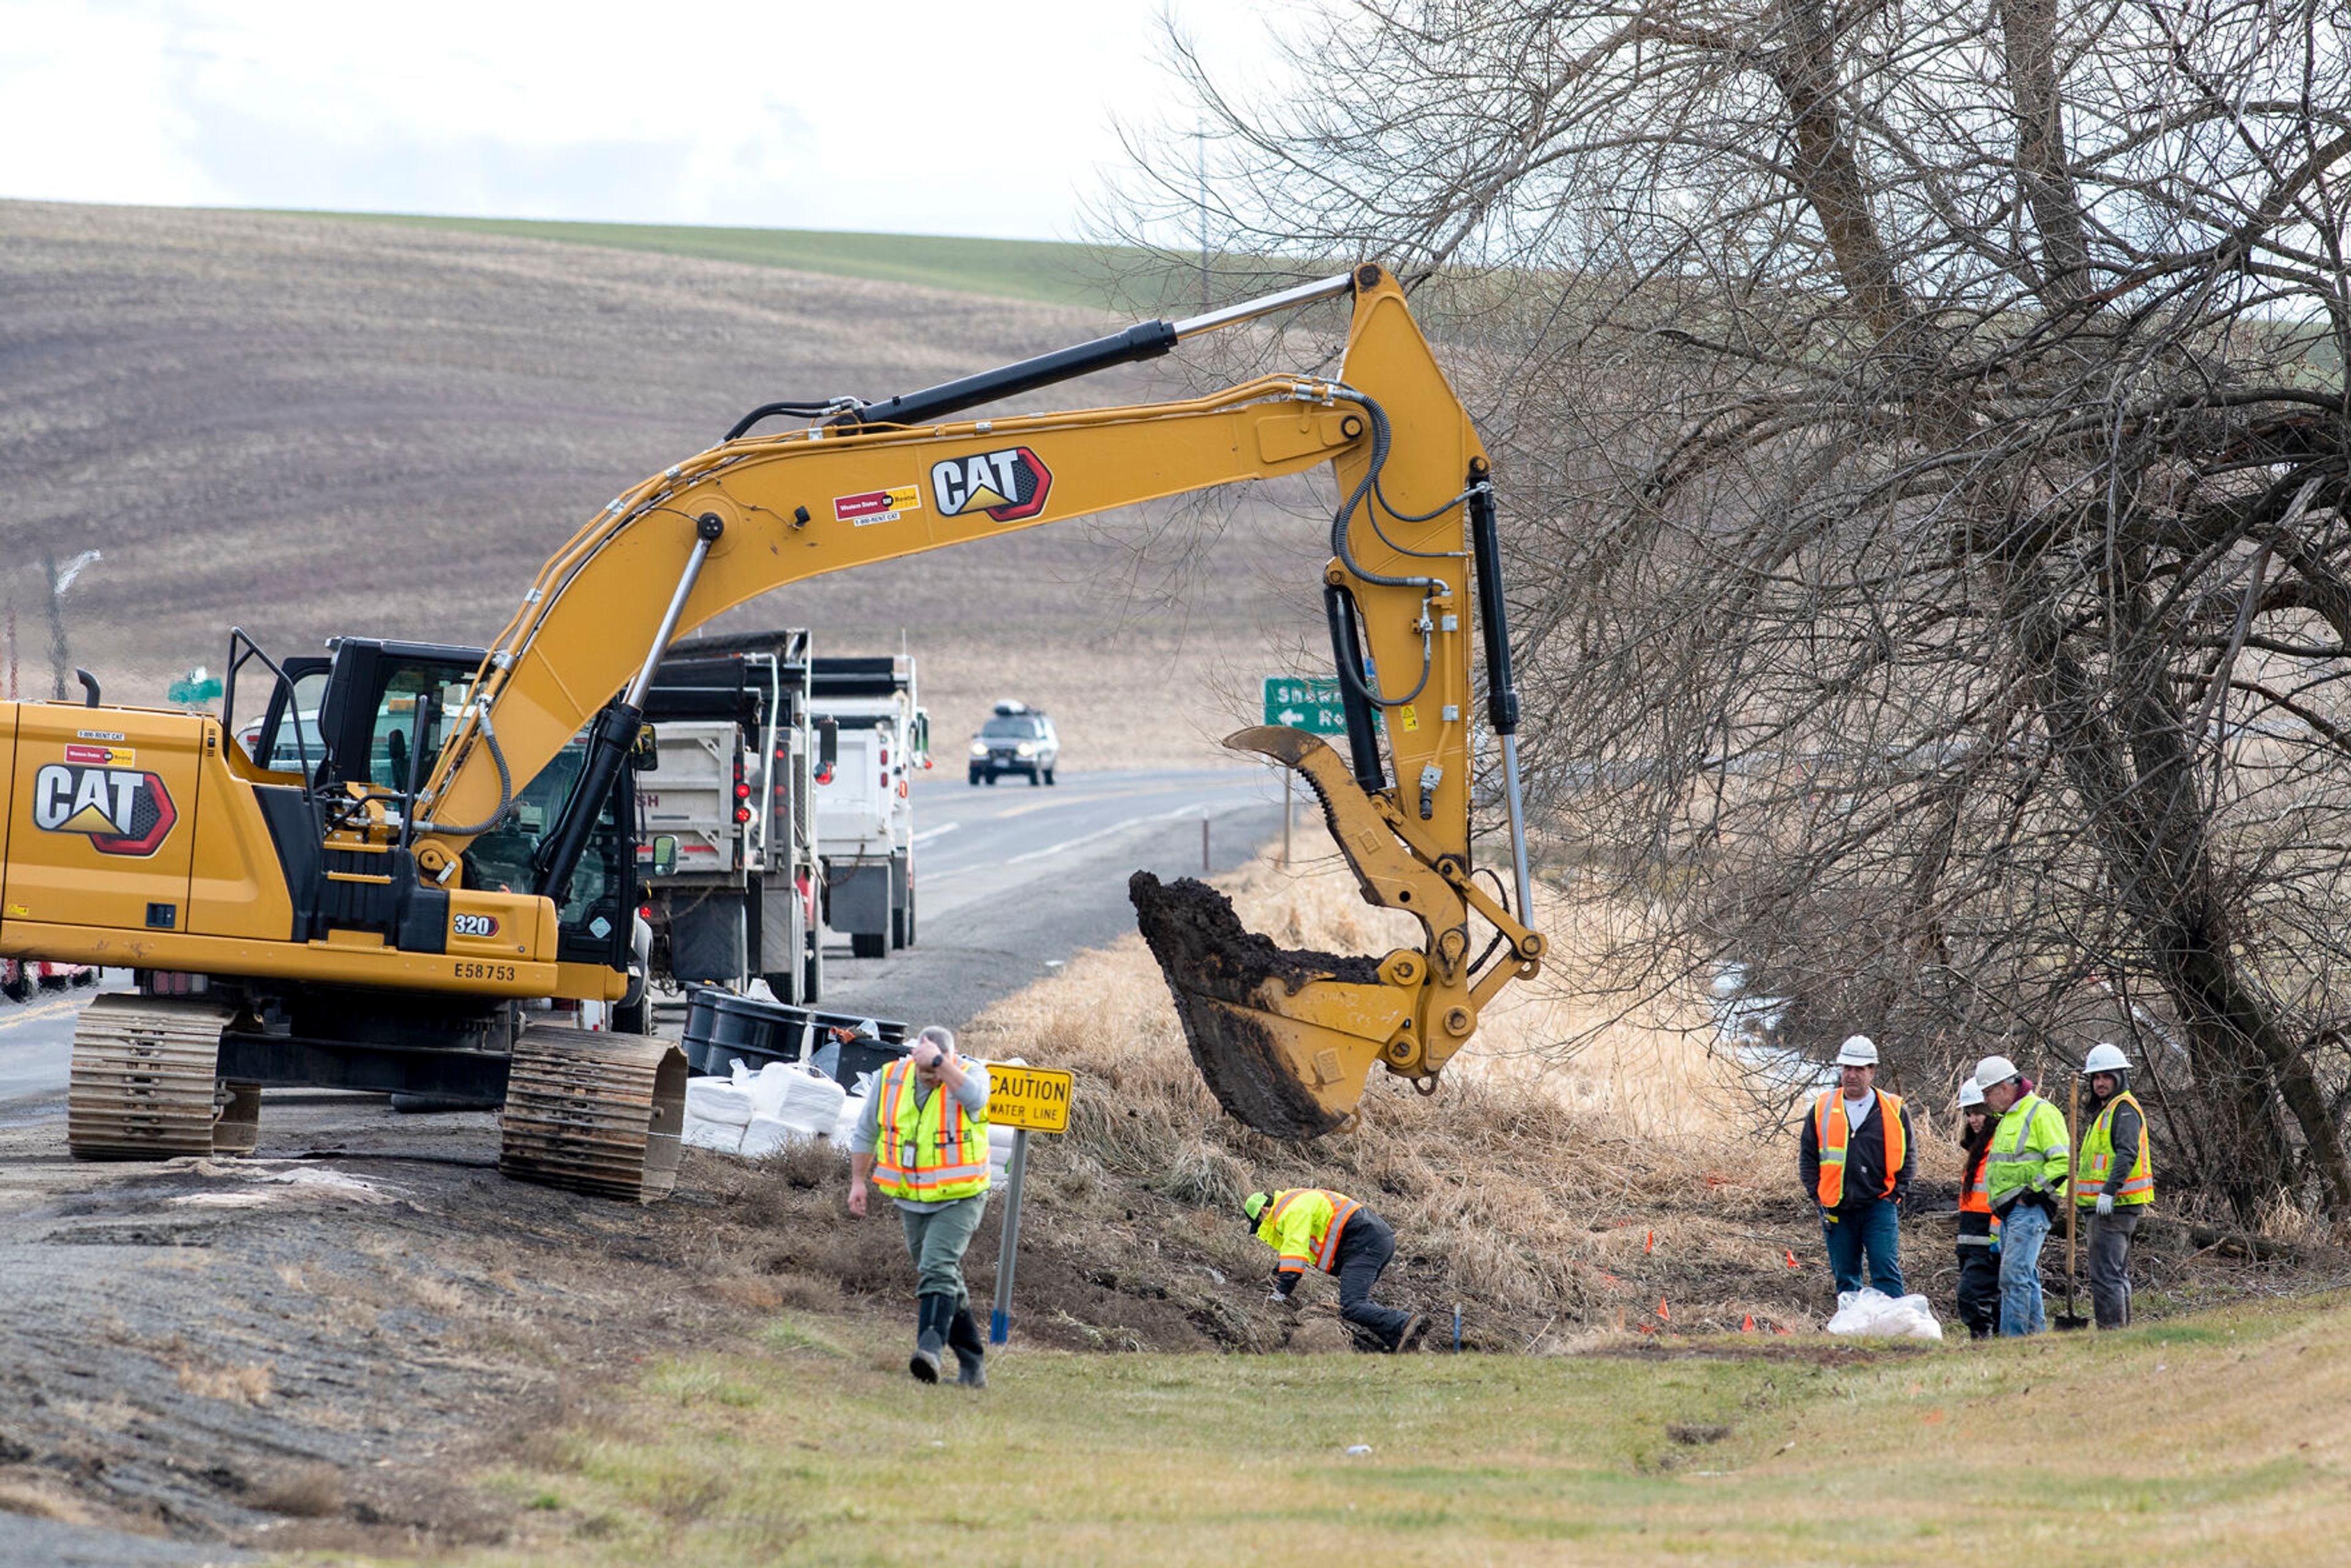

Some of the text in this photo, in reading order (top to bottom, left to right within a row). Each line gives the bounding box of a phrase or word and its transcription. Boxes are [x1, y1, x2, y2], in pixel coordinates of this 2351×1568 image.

[932, 449, 1018, 514] CAT
[1277, 686, 1343, 703] Shawn
[1319, 710, 1344, 726] Ro
[36, 765, 144, 835] CAT
[454, 914, 490, 936] 320
[455, 962, 515, 981] E58753
[990, 1103, 1057, 1121] WATER LINE
